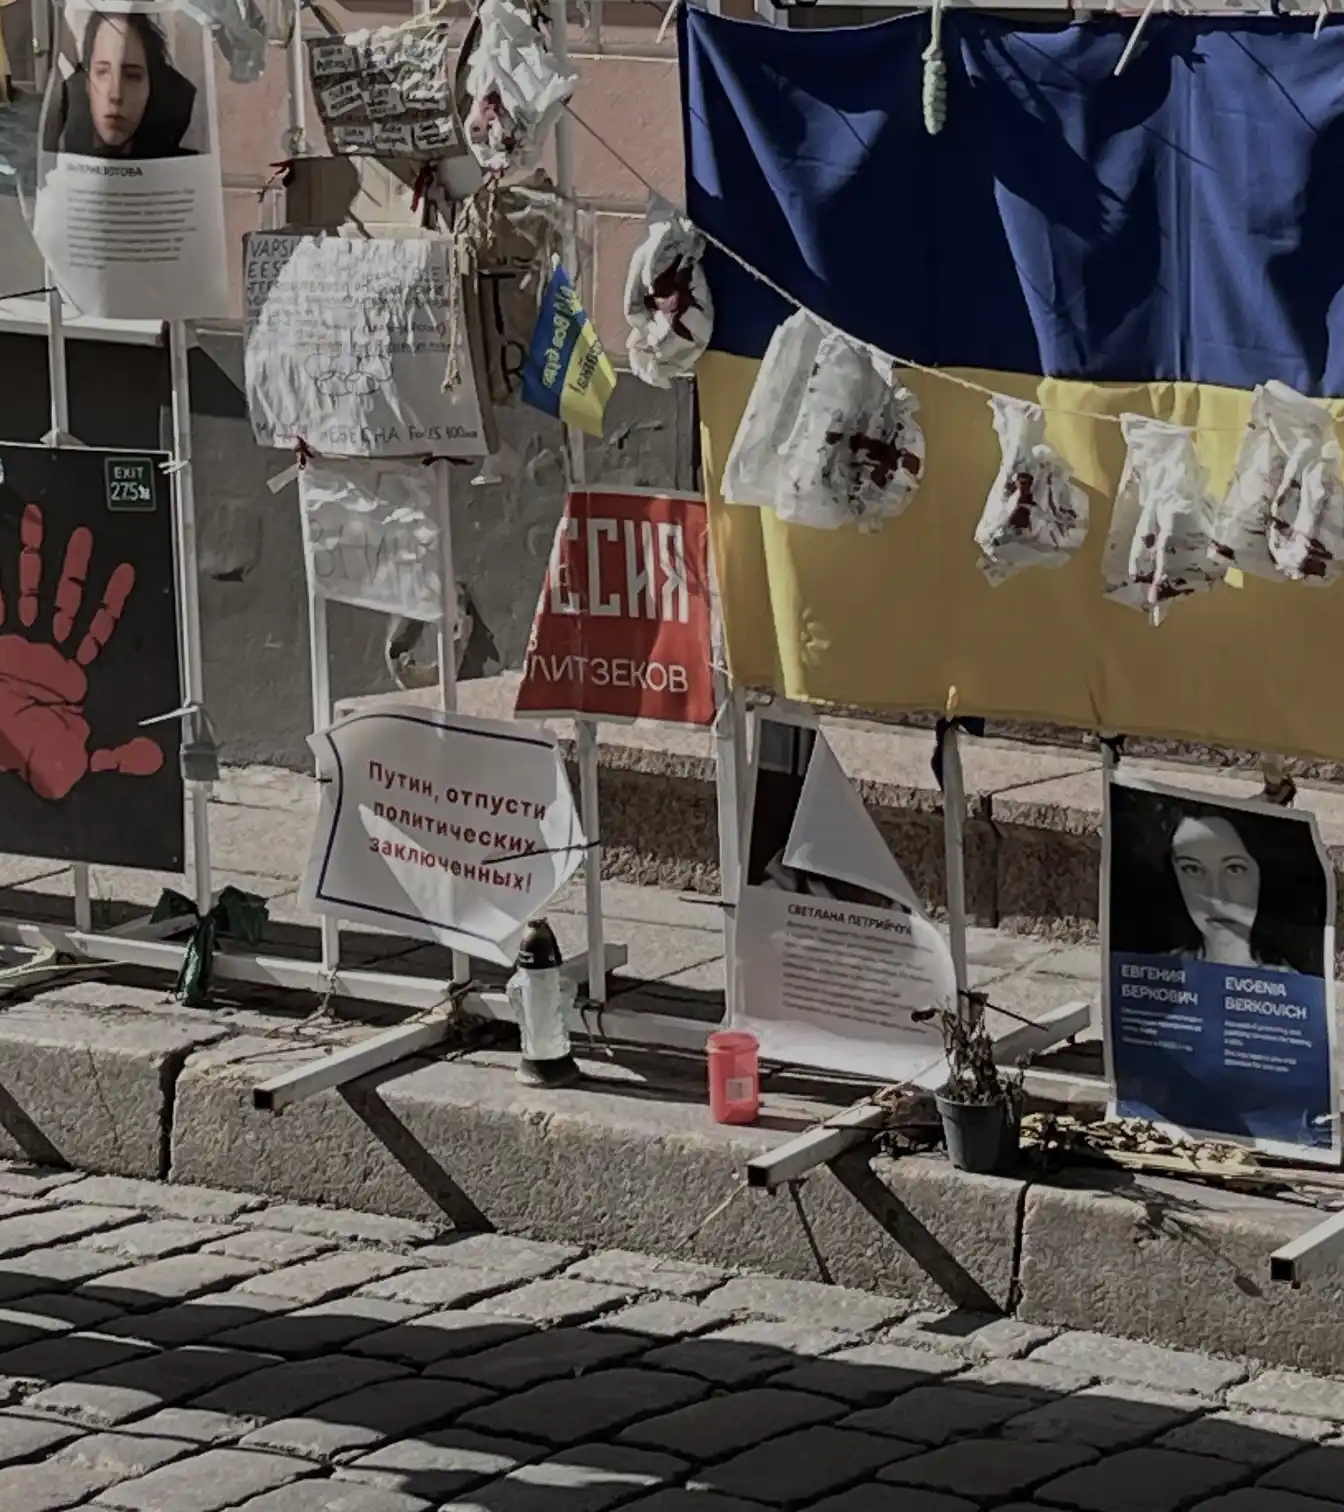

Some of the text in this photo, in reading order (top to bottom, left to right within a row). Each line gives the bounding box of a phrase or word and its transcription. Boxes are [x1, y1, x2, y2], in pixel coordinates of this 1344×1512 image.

[112, 465, 146, 480] EXIT
[109, 480, 140, 502] 275
[528, 652, 690, 694] ЛИТЗЕКОВ
[368, 760, 546, 821] Путин, отпусти
[372, 801, 537, 855] политических
[368, 837, 533, 894] заключенных!
[787, 903, 846, 925] СВЕТЛАНА
[1120, 963, 1187, 985] ЕВГЕНИЯ
[1121, 983, 1199, 1007] БЕРКОВИЧ
[1224, 975, 1287, 998] EVGENIA
[1224, 995, 1308, 1020] BERKOVICH
